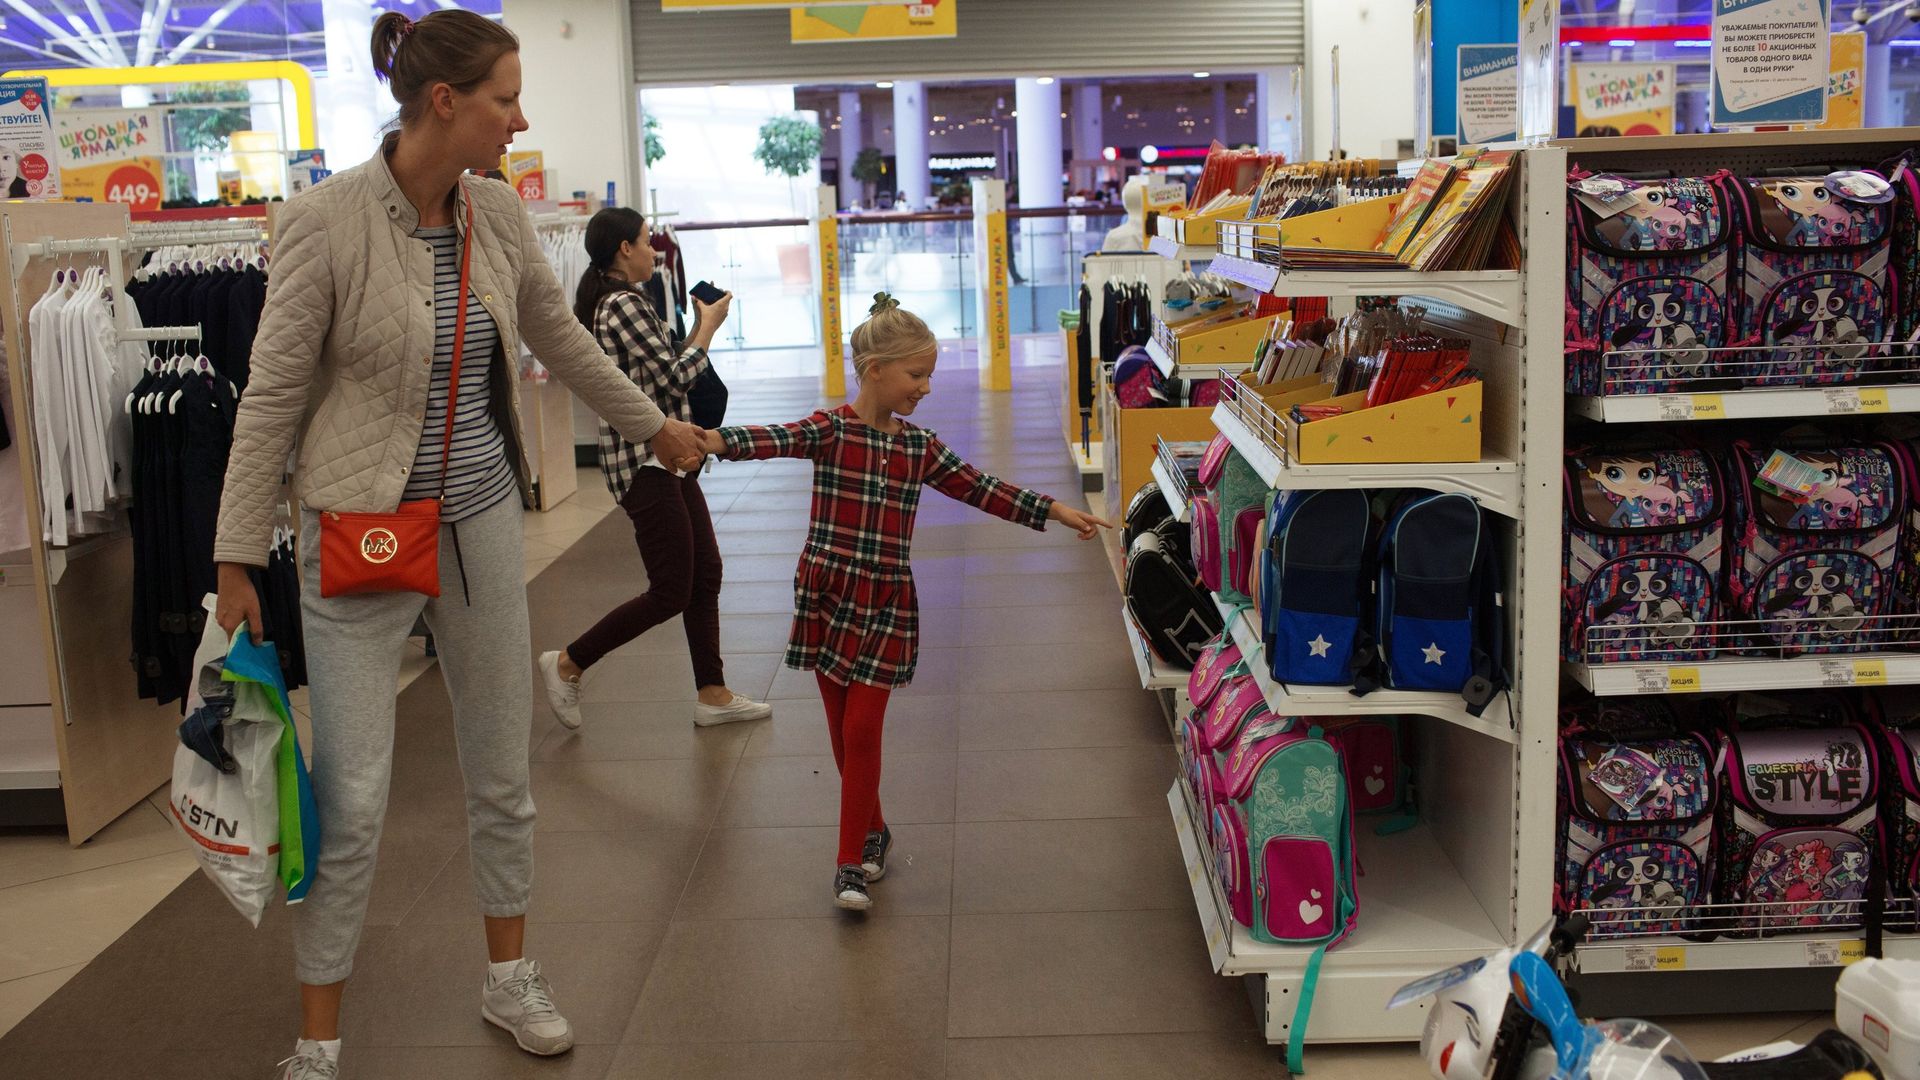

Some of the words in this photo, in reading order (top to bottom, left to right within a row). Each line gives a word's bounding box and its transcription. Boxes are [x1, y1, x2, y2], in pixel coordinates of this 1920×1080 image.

[1721, 23, 1767, 31] УВАЖАЕМЫЕ
[1768, 21, 1818, 30] ПОКУПАТЕЛИ!
[1769, 32, 1815, 40] ПРИОБРЕСТИ
[1757, 42, 1768, 51] 10
[1769, 43, 1816, 51] АКЦИОННЫХ
[1726, 55, 1758, 63] ТОВАРОВ
[1792, 53, 1812, 61] ВИДА
[1586, 69, 1664, 99] ШКОЛЬНАЯ
[1595, 84, 1661, 109] ЯРМАРКА
[0, 113, 42, 125] ТВУЙТЕ!
[60, 115, 148, 148] ШКОЛЬНАЯ
[71, 132, 147, 159] ЯРМАРКА
[1694, 404, 1718, 412] АКЦИЯ
[1666, 461, 1705, 474] STYLES
[1850, 462, 1889, 476] STYLES
[1671, 678, 1694, 686] АКЦИЯ
[1664, 753, 1700, 767] STYLES
[1747, 761, 1818, 776] EQUESTRIA
[1754, 768, 1862, 802] STYLE
